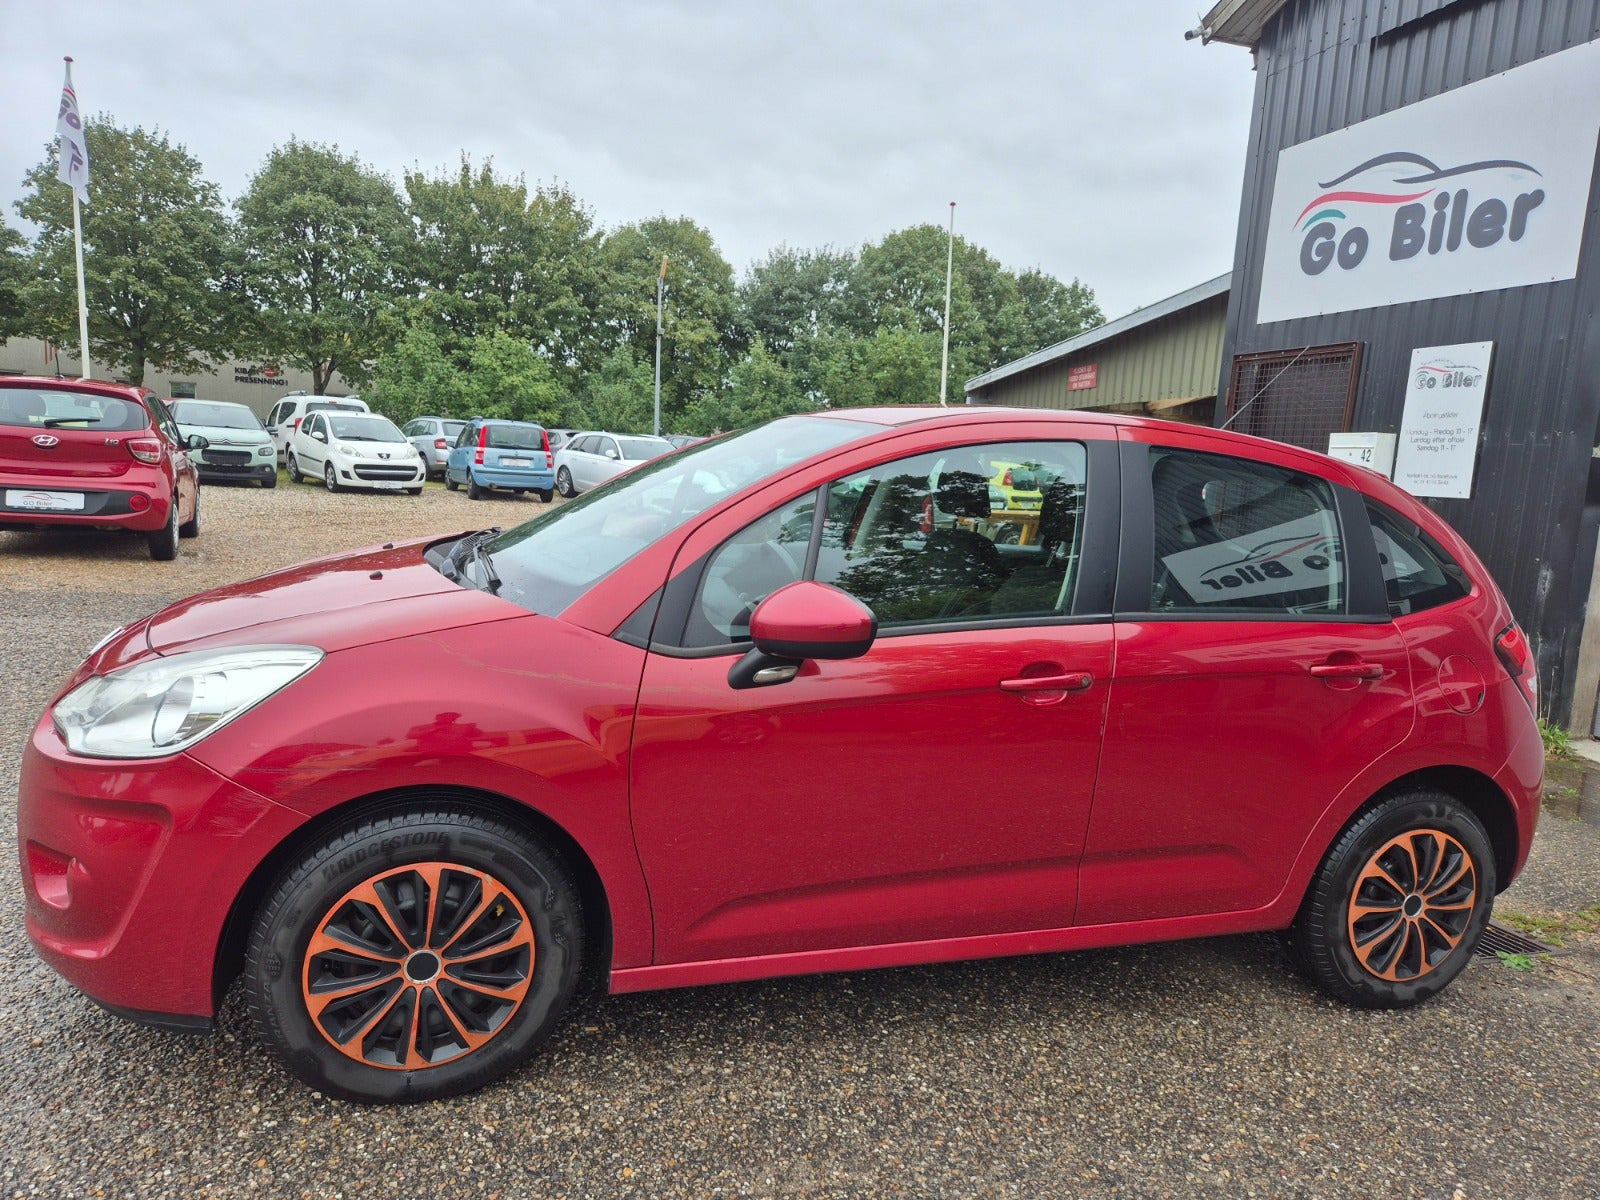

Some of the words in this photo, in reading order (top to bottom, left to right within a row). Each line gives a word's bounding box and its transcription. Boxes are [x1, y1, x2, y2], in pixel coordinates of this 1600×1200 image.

[1300, 222, 1369, 276] Go
[1389, 188, 1545, 261] Biler
[1415, 374, 1436, 389] Go
[1442, 371, 1482, 388] Biler
[1361, 449, 1372, 462] 42
